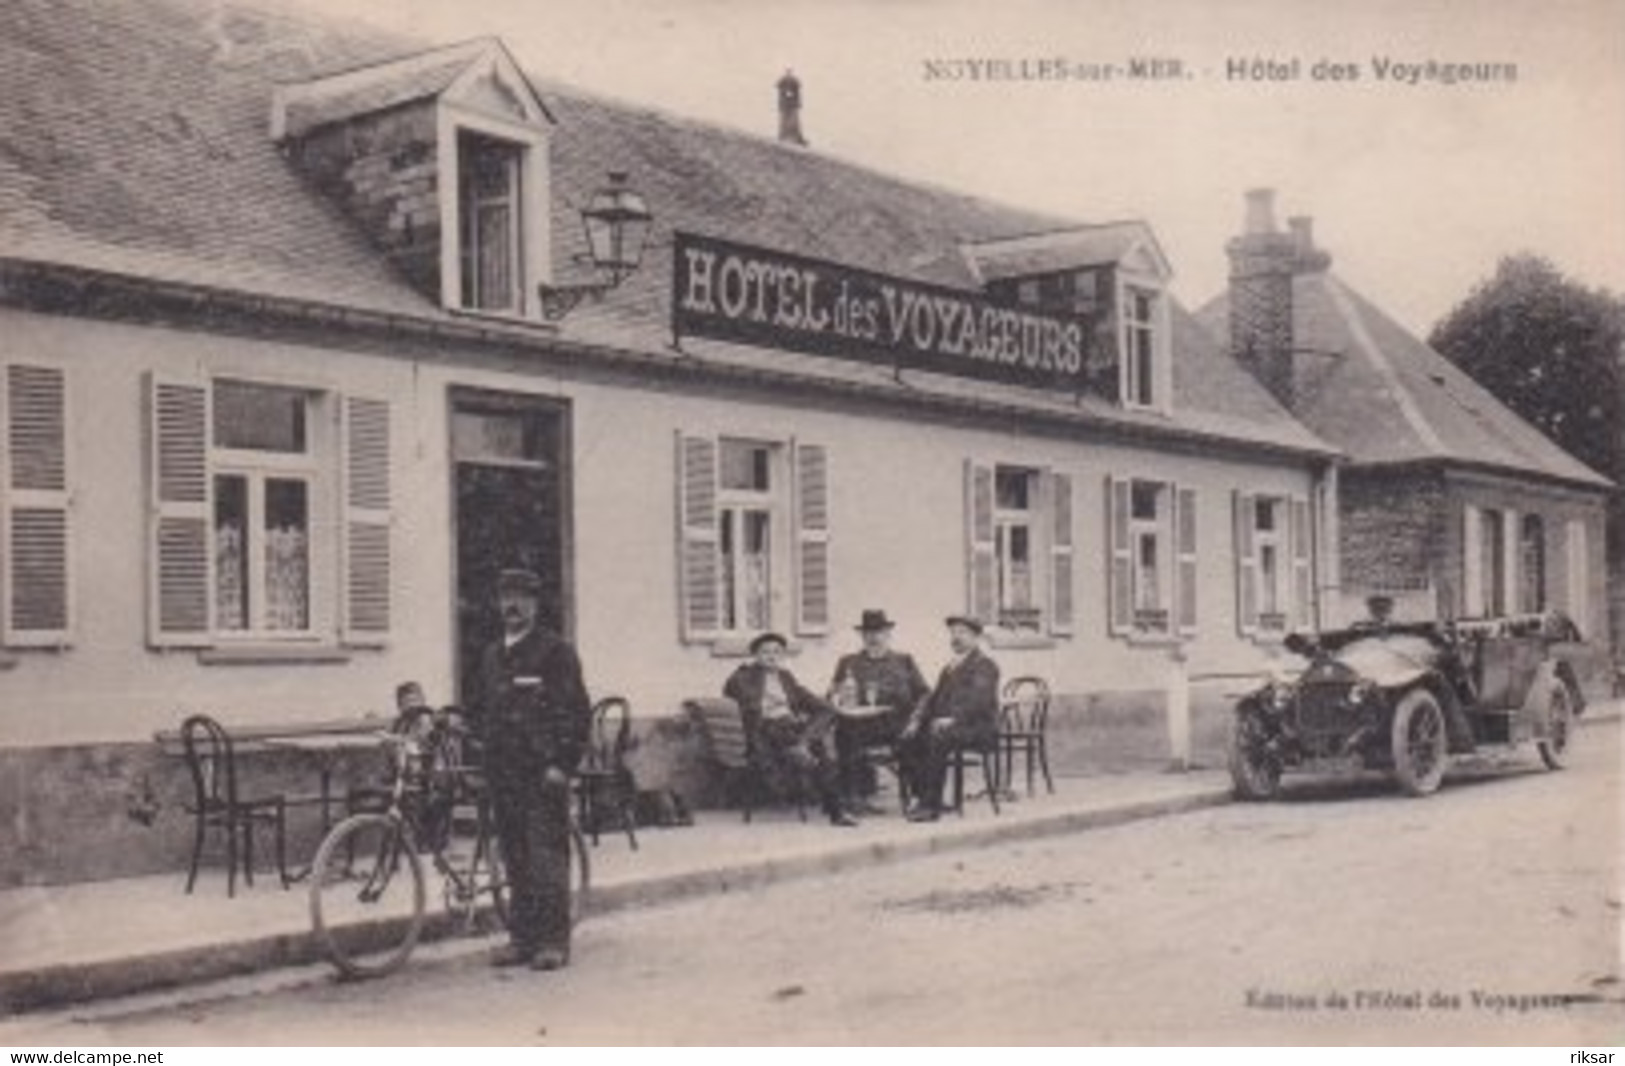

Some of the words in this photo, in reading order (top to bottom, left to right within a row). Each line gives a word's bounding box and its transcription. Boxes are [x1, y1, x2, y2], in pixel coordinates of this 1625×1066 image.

[683, 248, 830, 330] HOTEL
[833, 280, 878, 340] des
[881, 286, 1082, 374] VOYAGEURS
